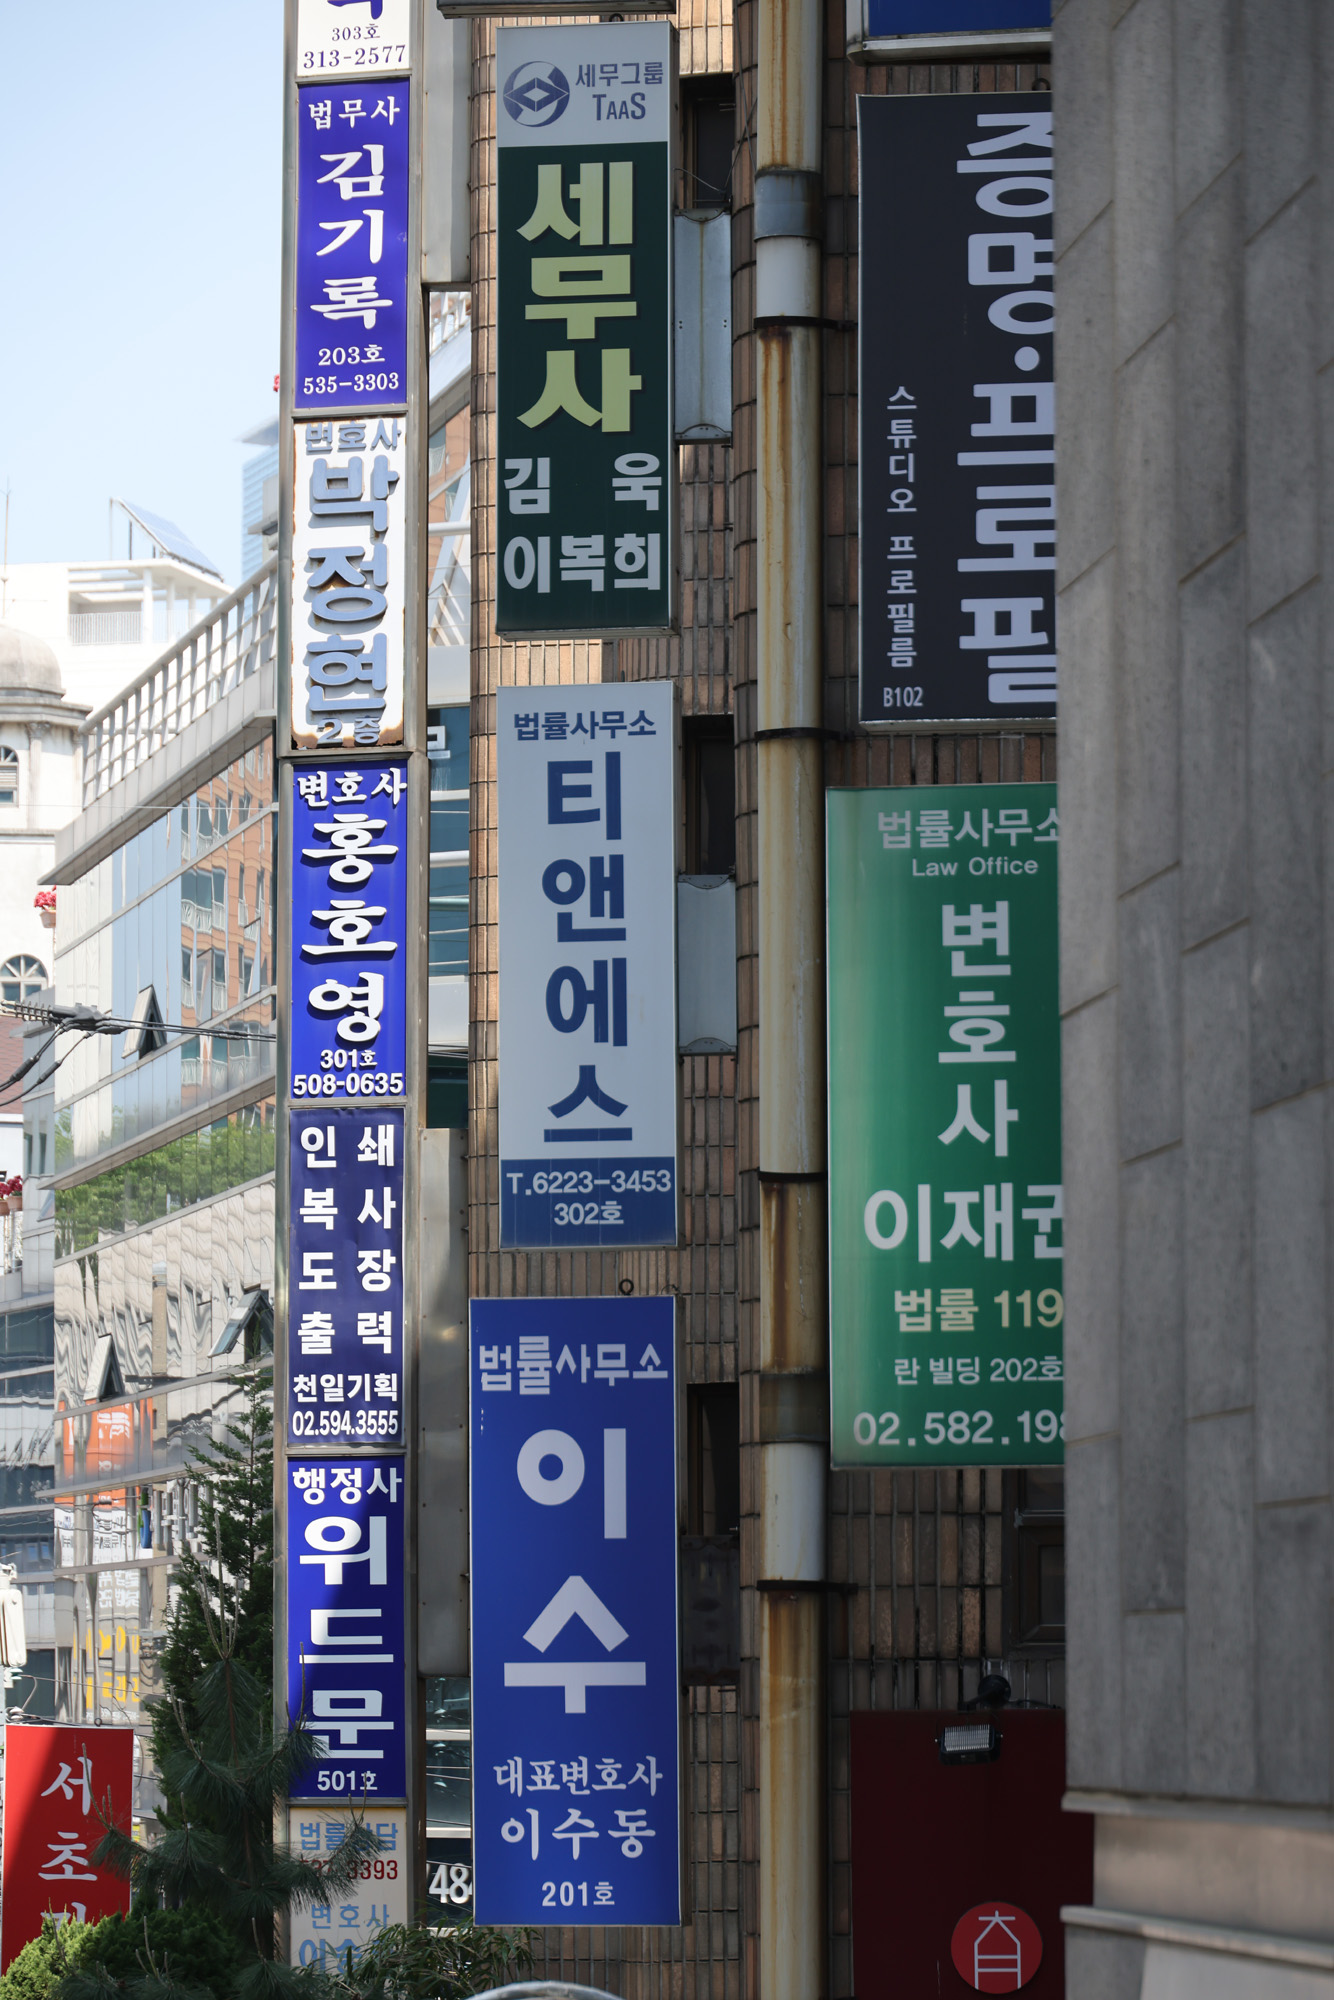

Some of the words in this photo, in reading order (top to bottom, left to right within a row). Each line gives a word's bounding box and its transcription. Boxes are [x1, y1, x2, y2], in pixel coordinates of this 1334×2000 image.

[331, 23, 381, 42] 303호
[303, 45, 406, 69] 313-2577
[575, 61, 664, 87] 세무그룹
[308, 96, 400, 130] 법무사
[310, 144, 393, 330] 김기록
[516, 161, 642, 433] 세무사
[318, 345, 386, 366] 203호
[303, 373, 399, 394] 535-3303
[305, 419, 402, 453] 변호사
[887, 386, 918, 513] 스튜디오
[503, 533, 661, 593] 이복희
[305, 454, 400, 712] 박정현
[887, 536, 918, 667] 프로필름
[883, 687, 923, 707] B102
[317, 715, 381, 745] 2층
[514, 709, 657, 741] 법률사무소
[297, 767, 408, 807] 변호사
[912, 858, 958, 877] Law
[968, 856, 1039, 876] Office
[301, 813, 399, 1043] 홍호영
[542, 751, 633, 1142] 티앤에스
[938, 900, 1018, 1157] 변호사
[320, 1049, 378, 1069] 301호
[293, 1073, 403, 1096] 508-0635
[554, 1201, 625, 1226] 302호
[894, 1287, 979, 1332] 법률
[994, 1287, 1064, 1328] 119
[479, 1335, 669, 1395] 법률사무소
[989, 1355, 1064, 1383] 202호
[293, 1372, 398, 1402] 천일기획
[292, 1409, 398, 1437] 02.594.3555
[853, 1409, 1066, 1447] 02.582.19
[293, 1467, 402, 1504] 행정사
[503, 1428, 646, 1714] 이수
[299, 1515, 394, 1759] 위드문
[317, 1769, 378, 1792] 501호
[493, 1755, 663, 1797] 대표변호사
[300, 1822, 398, 1851] 법률담
[500, 1807, 657, 1862] 이수동
[542, 1881, 616, 1908] 201호
[311, 1904, 390, 1930] 변호사
